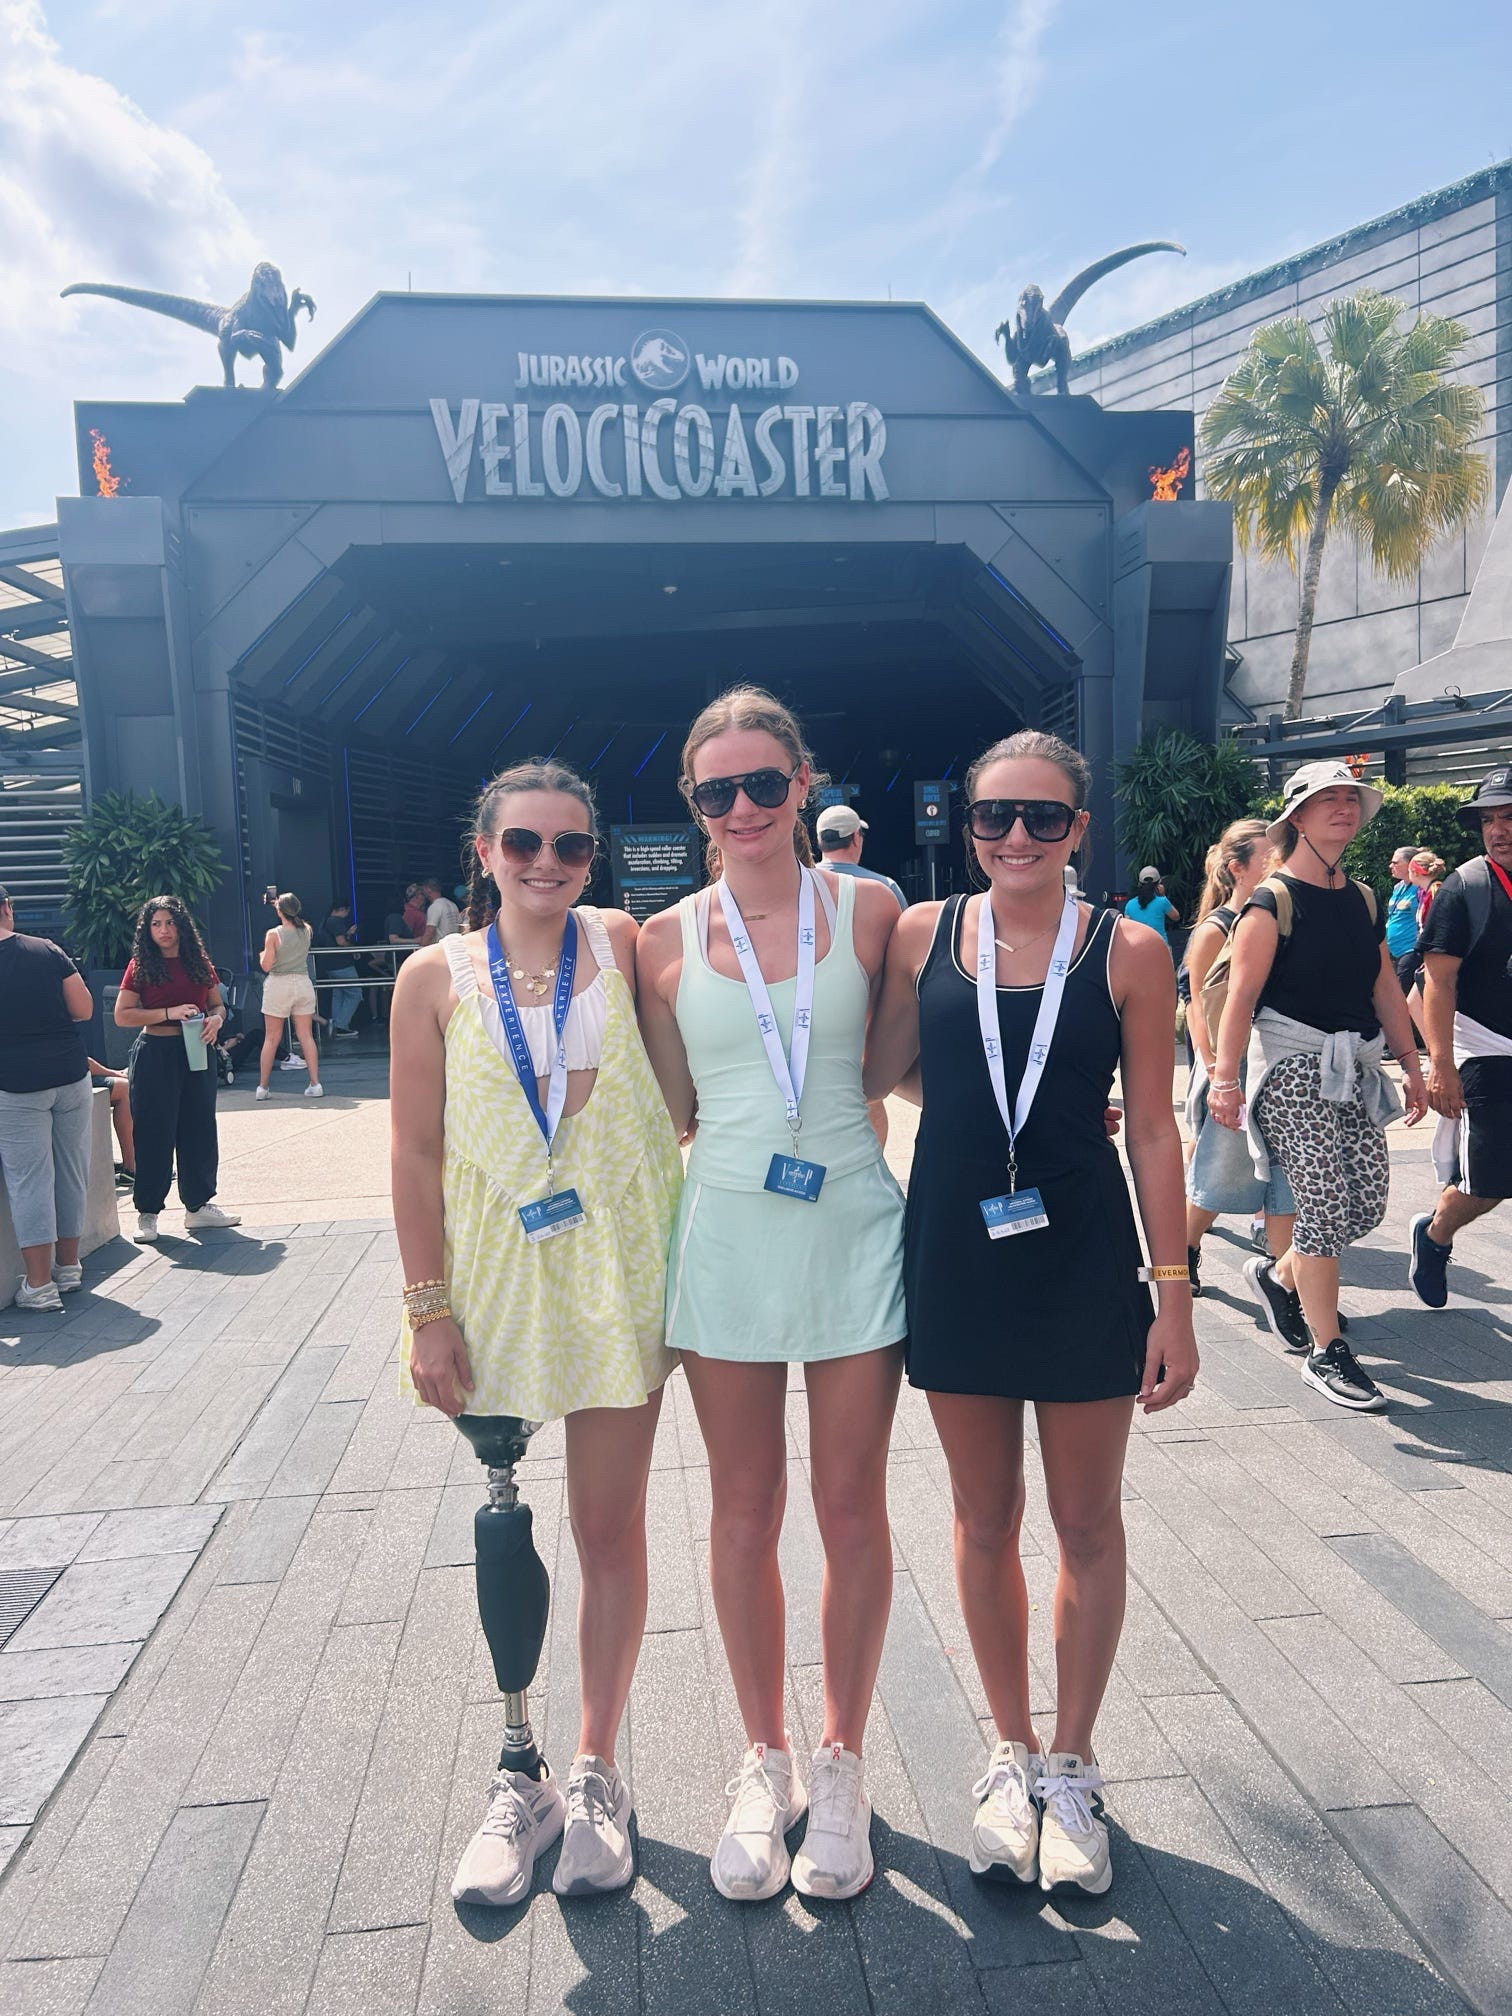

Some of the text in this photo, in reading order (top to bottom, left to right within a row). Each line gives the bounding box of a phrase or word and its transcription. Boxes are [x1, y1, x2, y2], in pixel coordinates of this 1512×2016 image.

[514, 351, 800, 390] JURASSIC WORLD
[429, 397, 890, 504] VELOCICOASTER
[499, 984, 529, 1071] EXPERIENCE
